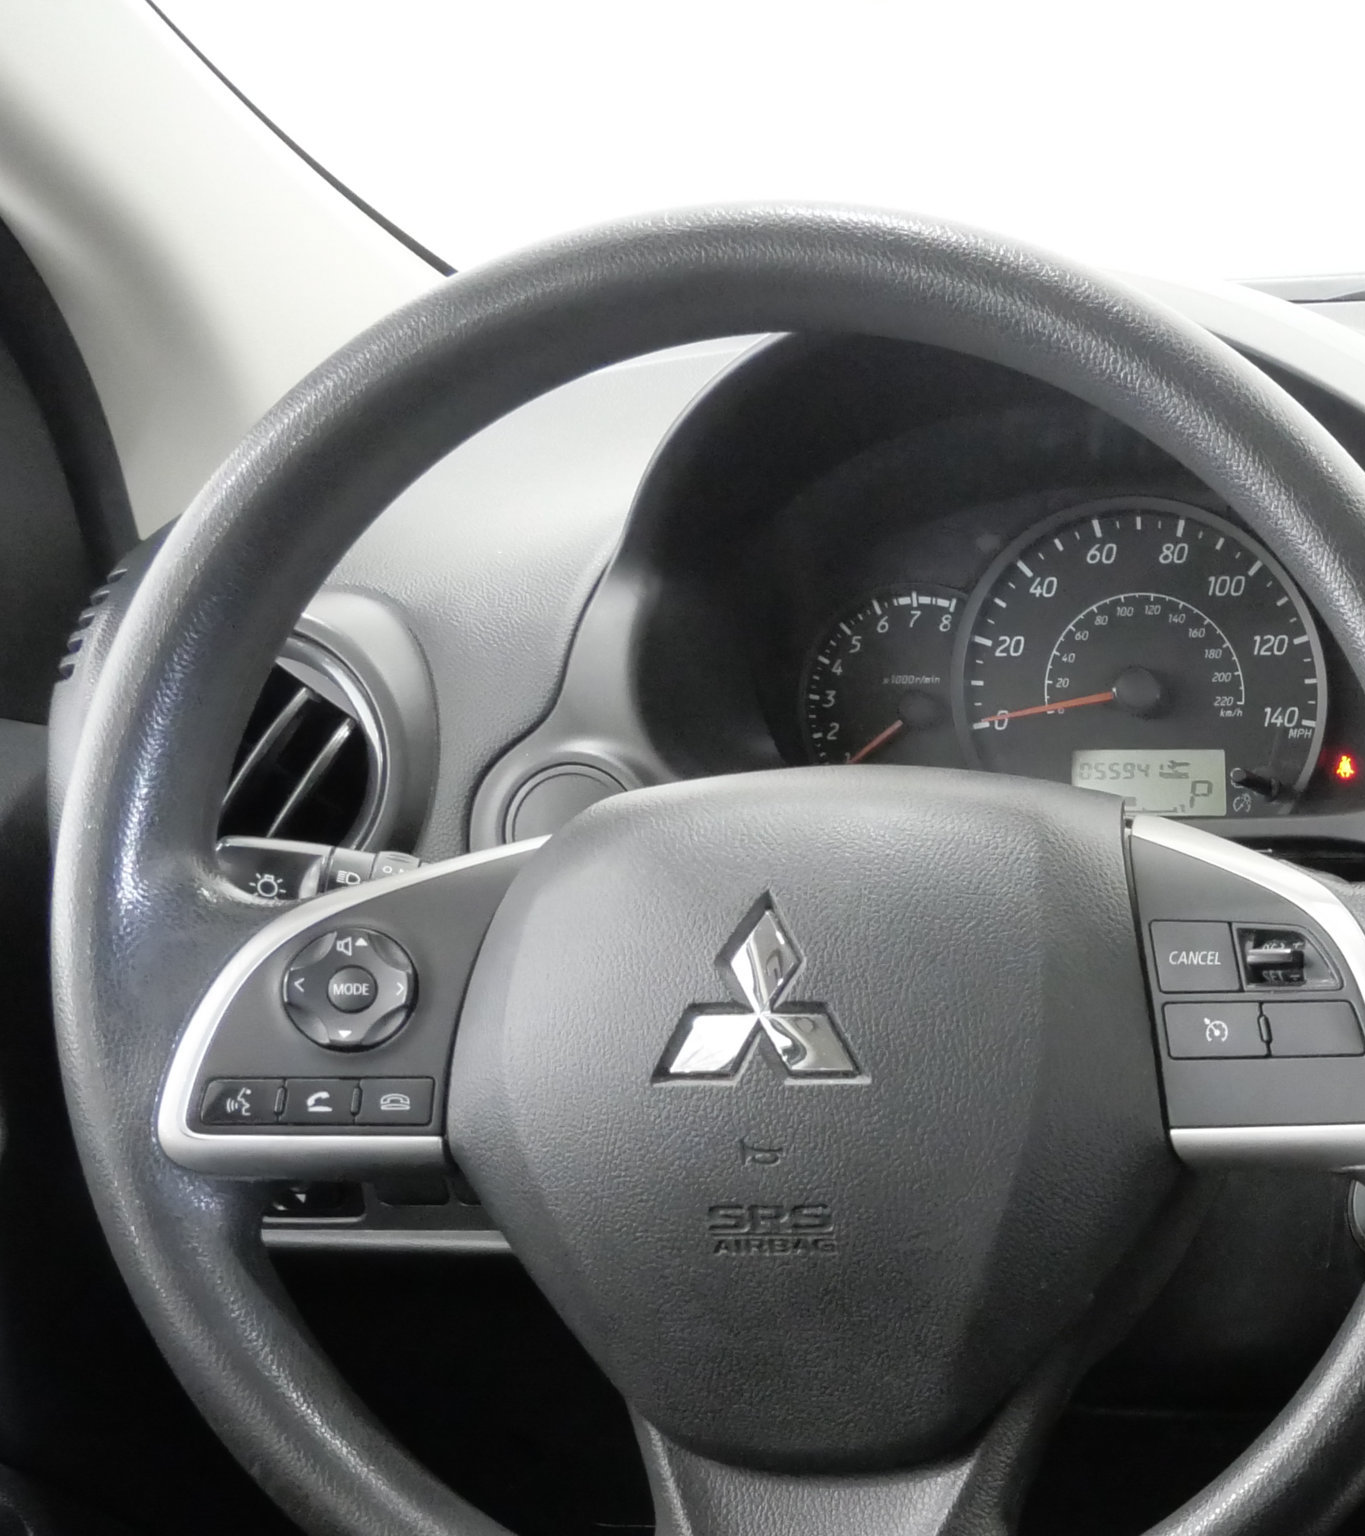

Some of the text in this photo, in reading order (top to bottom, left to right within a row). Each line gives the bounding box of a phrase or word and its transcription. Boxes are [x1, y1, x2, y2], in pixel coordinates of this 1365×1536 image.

[1085, 543, 1117, 565] 60
[1158, 543, 1189, 564] 80
[1029, 576, 1058, 598] 40
[1207, 575, 1246, 597] 100
[1116, 606, 1135, 617] 100
[1144, 604, 1162, 616] 120
[1168, 613, 1187, 625] 140
[876, 615, 889, 634] 6
[909, 610, 922, 629] 7
[938, 614, 953, 633] 8
[1094, 615, 1109, 627] 80
[1074, 630, 1090, 642] 60
[1188, 627, 1206, 639] 160
[849, 635, 863, 653] 5
[994, 635, 1025, 658] 20
[1253, 634, 1289, 656] 120
[1061, 652, 1076, 664] 40
[1204, 648, 1223, 660] 180
[831, 659, 844, 677] 4
[1211, 671, 1232, 683] 200
[1055, 677, 1070, 689] 20
[822, 690, 837, 708] 3
[1213, 696, 1234, 708] 220
[994, 709, 1010, 731] 0
[1220, 708, 1243, 718] km/h
[1263, 707, 1300, 728] 140
[826, 722, 840, 741] 2
[1287, 728, 1313, 740] MPH
[1190, 779, 1213, 808] P
[1168, 950, 1222, 966] CANCEL
[332, 982, 370, 997] MODE
[707, 1203, 834, 1234] SRS
[711, 1237, 838, 1257] AIRBAG
